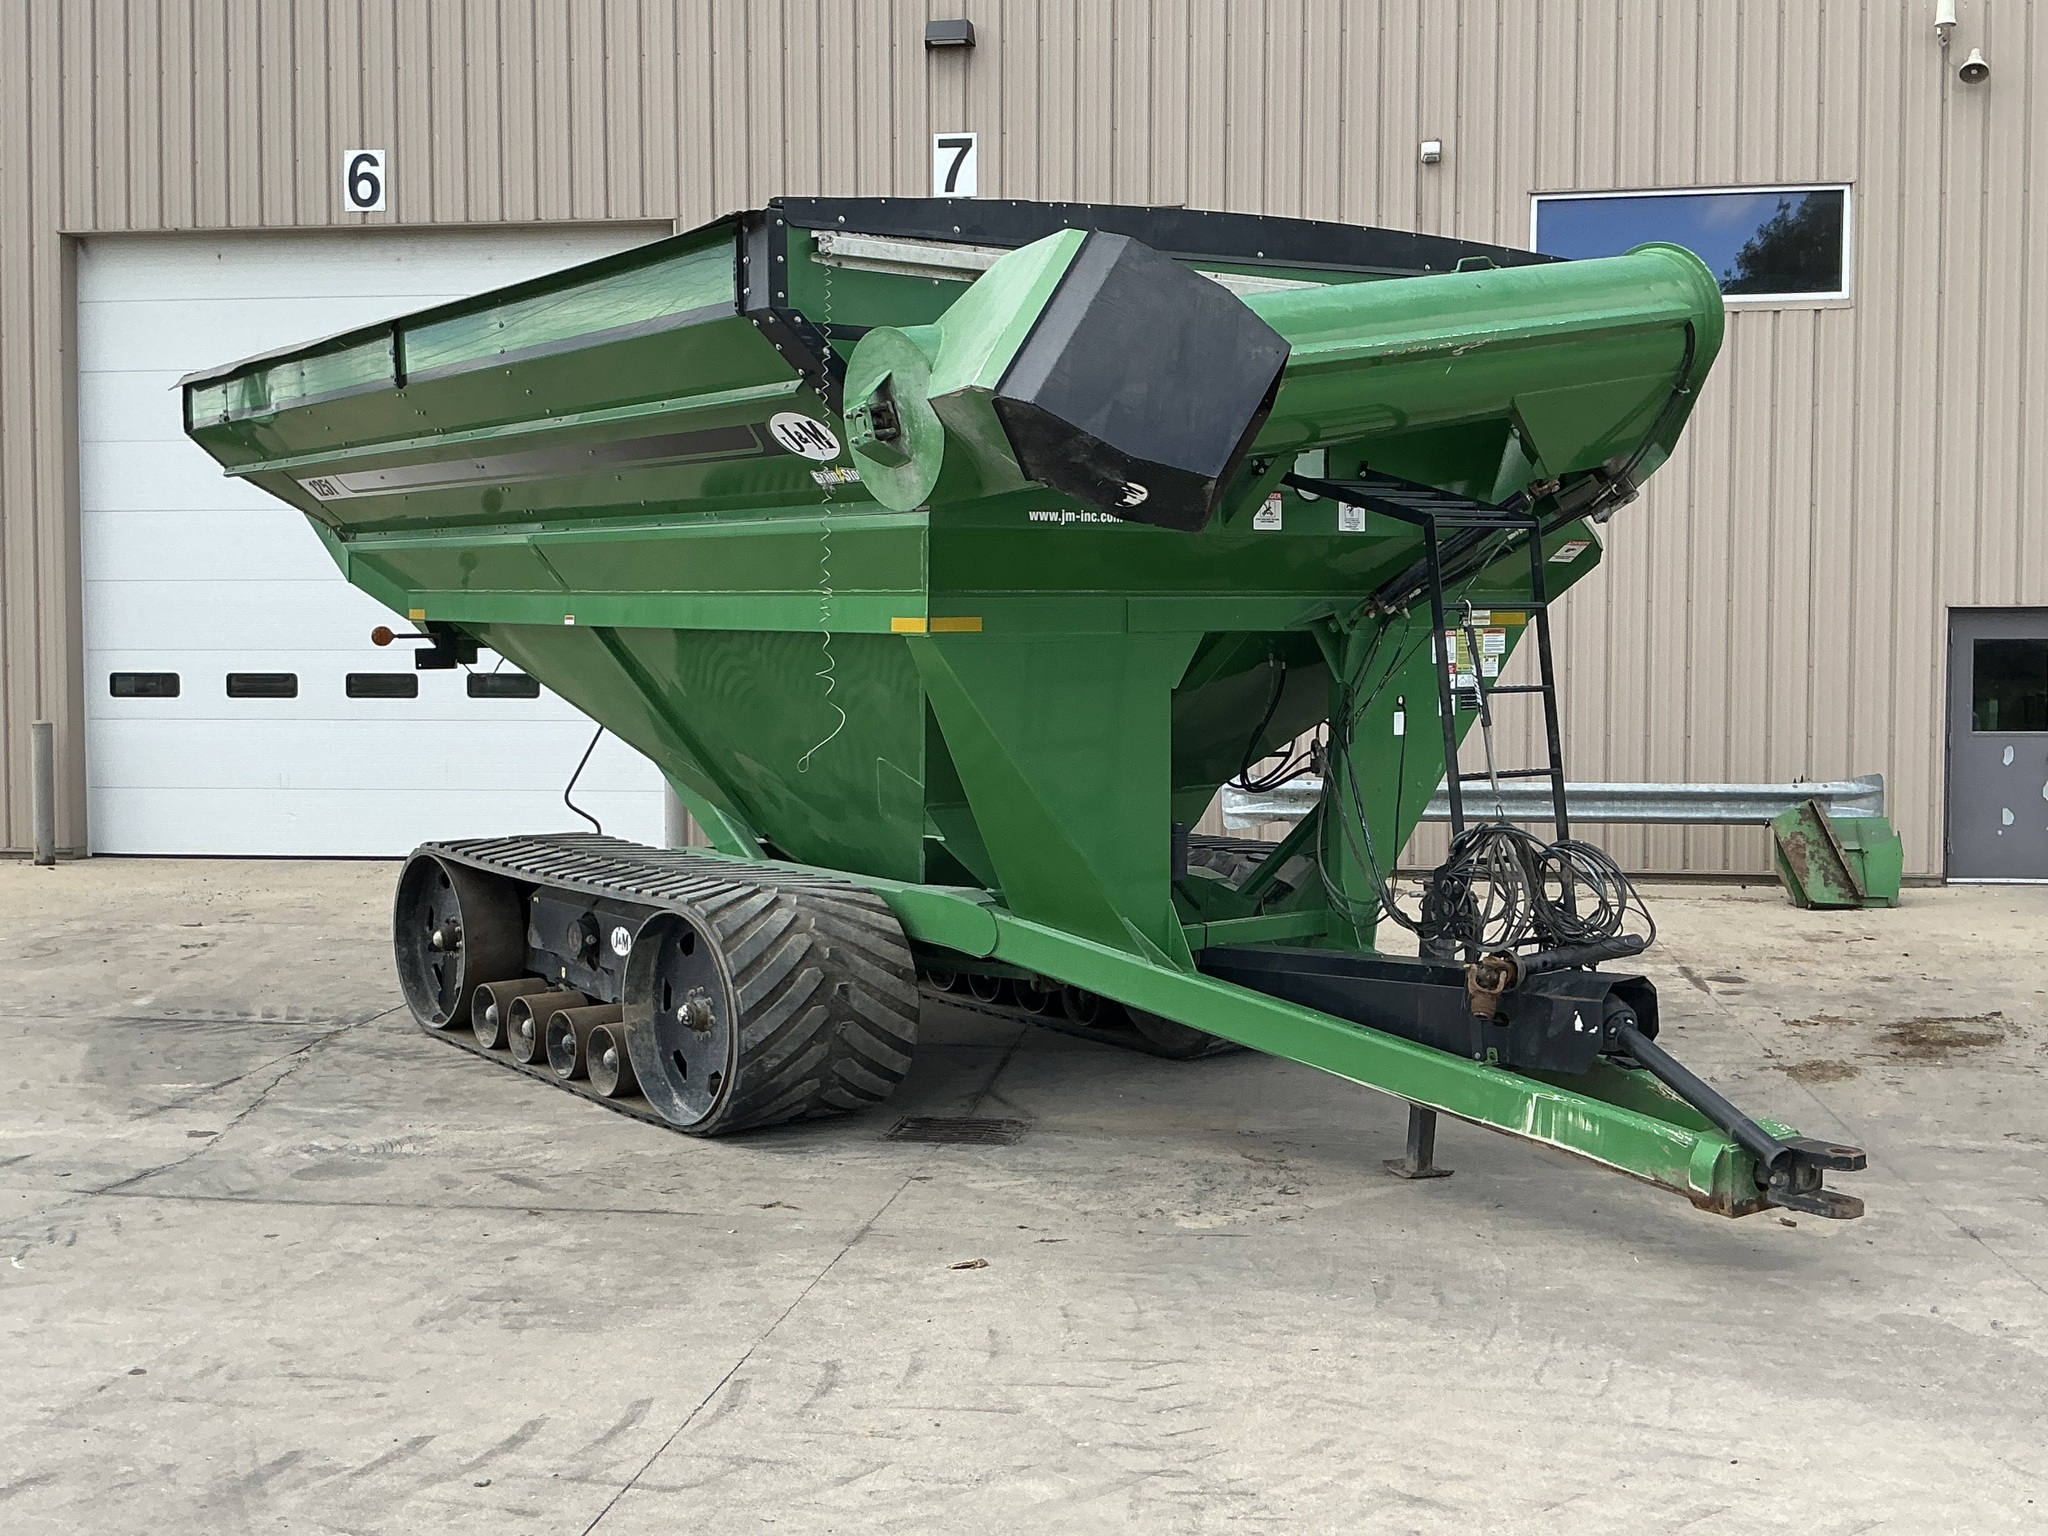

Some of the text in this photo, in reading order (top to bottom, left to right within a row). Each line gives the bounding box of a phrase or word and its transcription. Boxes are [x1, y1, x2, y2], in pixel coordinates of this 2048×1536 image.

[348, 153, 380, 207] 6
[938, 138, 972, 192] 7
[777, 420, 836, 452] J&M
[309, 479, 340, 496] 1251
[840, 468, 861, 482] Sto
